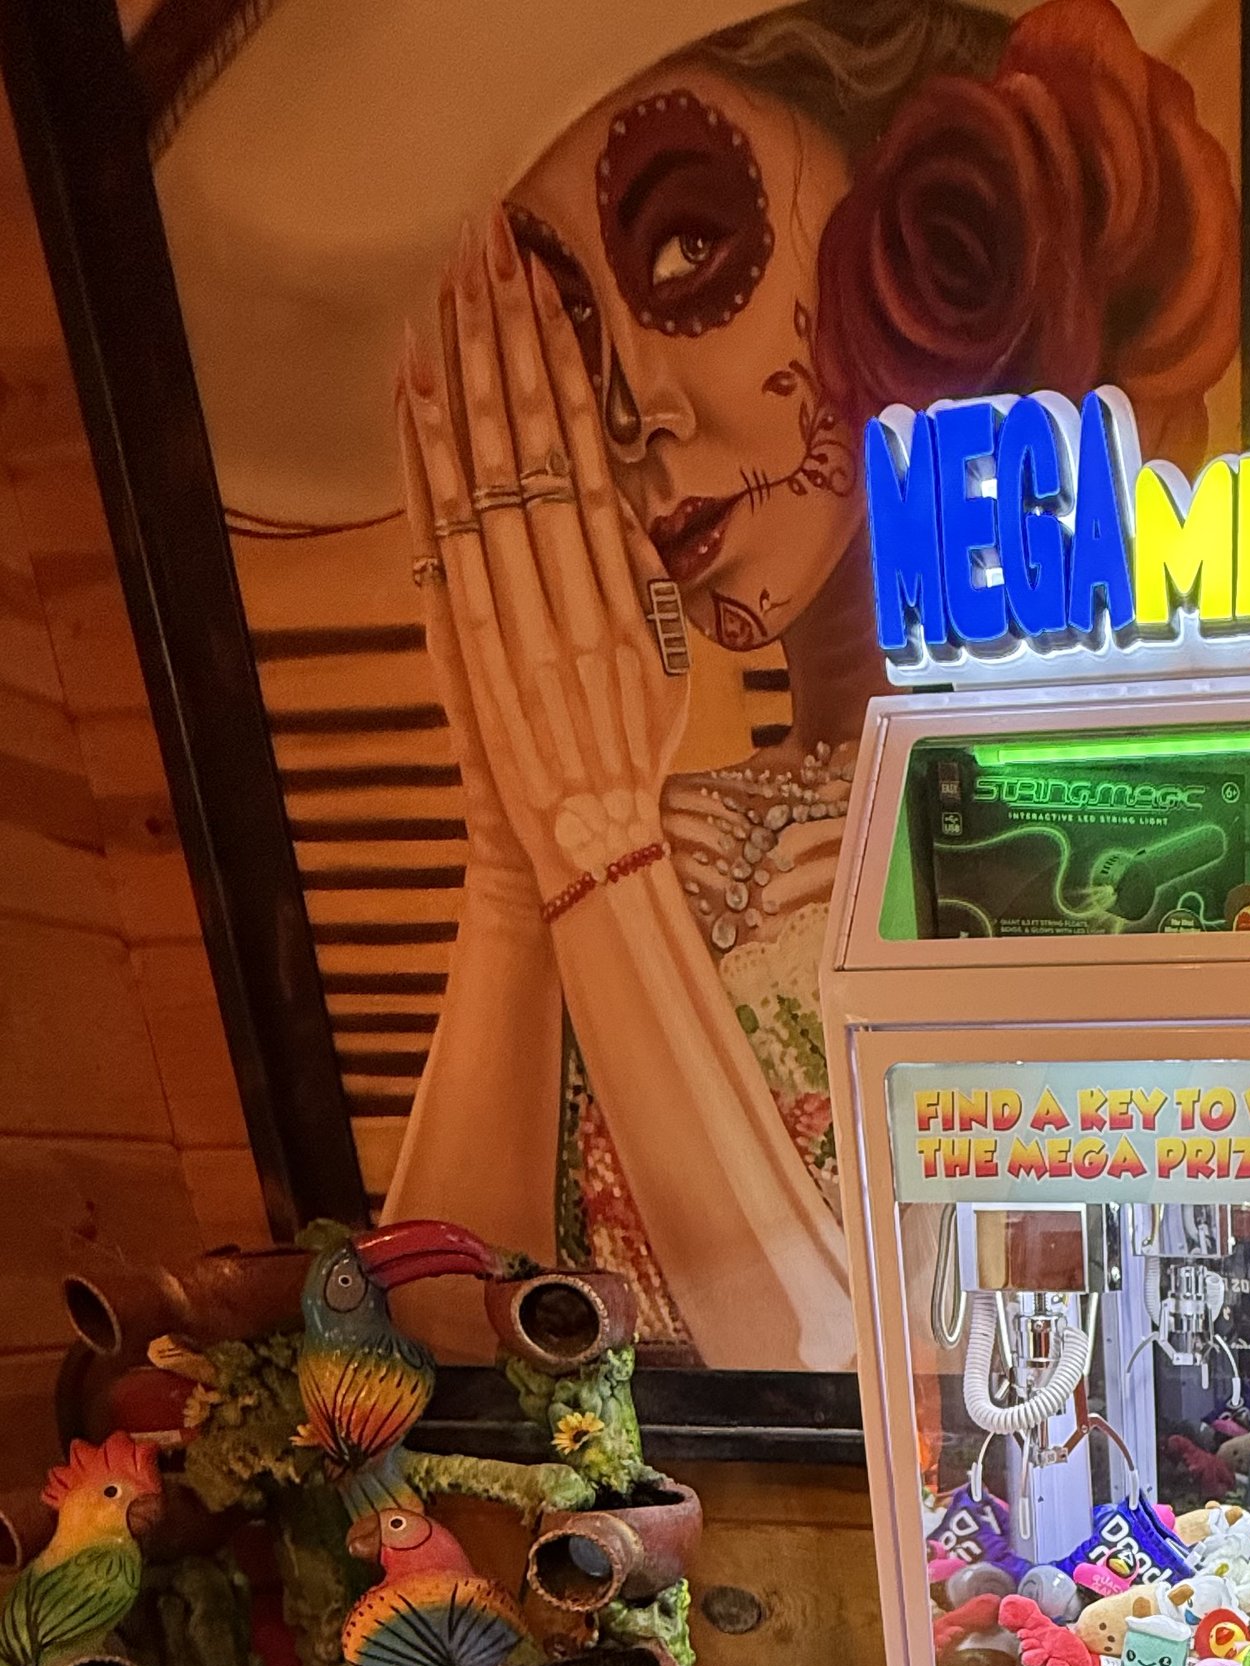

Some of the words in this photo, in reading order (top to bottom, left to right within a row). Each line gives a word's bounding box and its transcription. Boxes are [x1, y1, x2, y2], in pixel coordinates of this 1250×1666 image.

[865, 390, 1136, 649] MEGA
[1008, 811, 1073, 822] INTERACTIVE
[1077, 813, 1096, 823] LED
[1100, 814, 1136, 825] STRING
[1139, 816, 1168, 826] LIGHT
[914, 1087, 1023, 1133] FIND
[1029, 1087, 1069, 1132] A
[1078, 1087, 1169, 1133] KEY
[1173, 1087, 1237, 1131] TO
[917, 1135, 999, 1179] THE
[1006, 1133, 1147, 1180] MEGA
